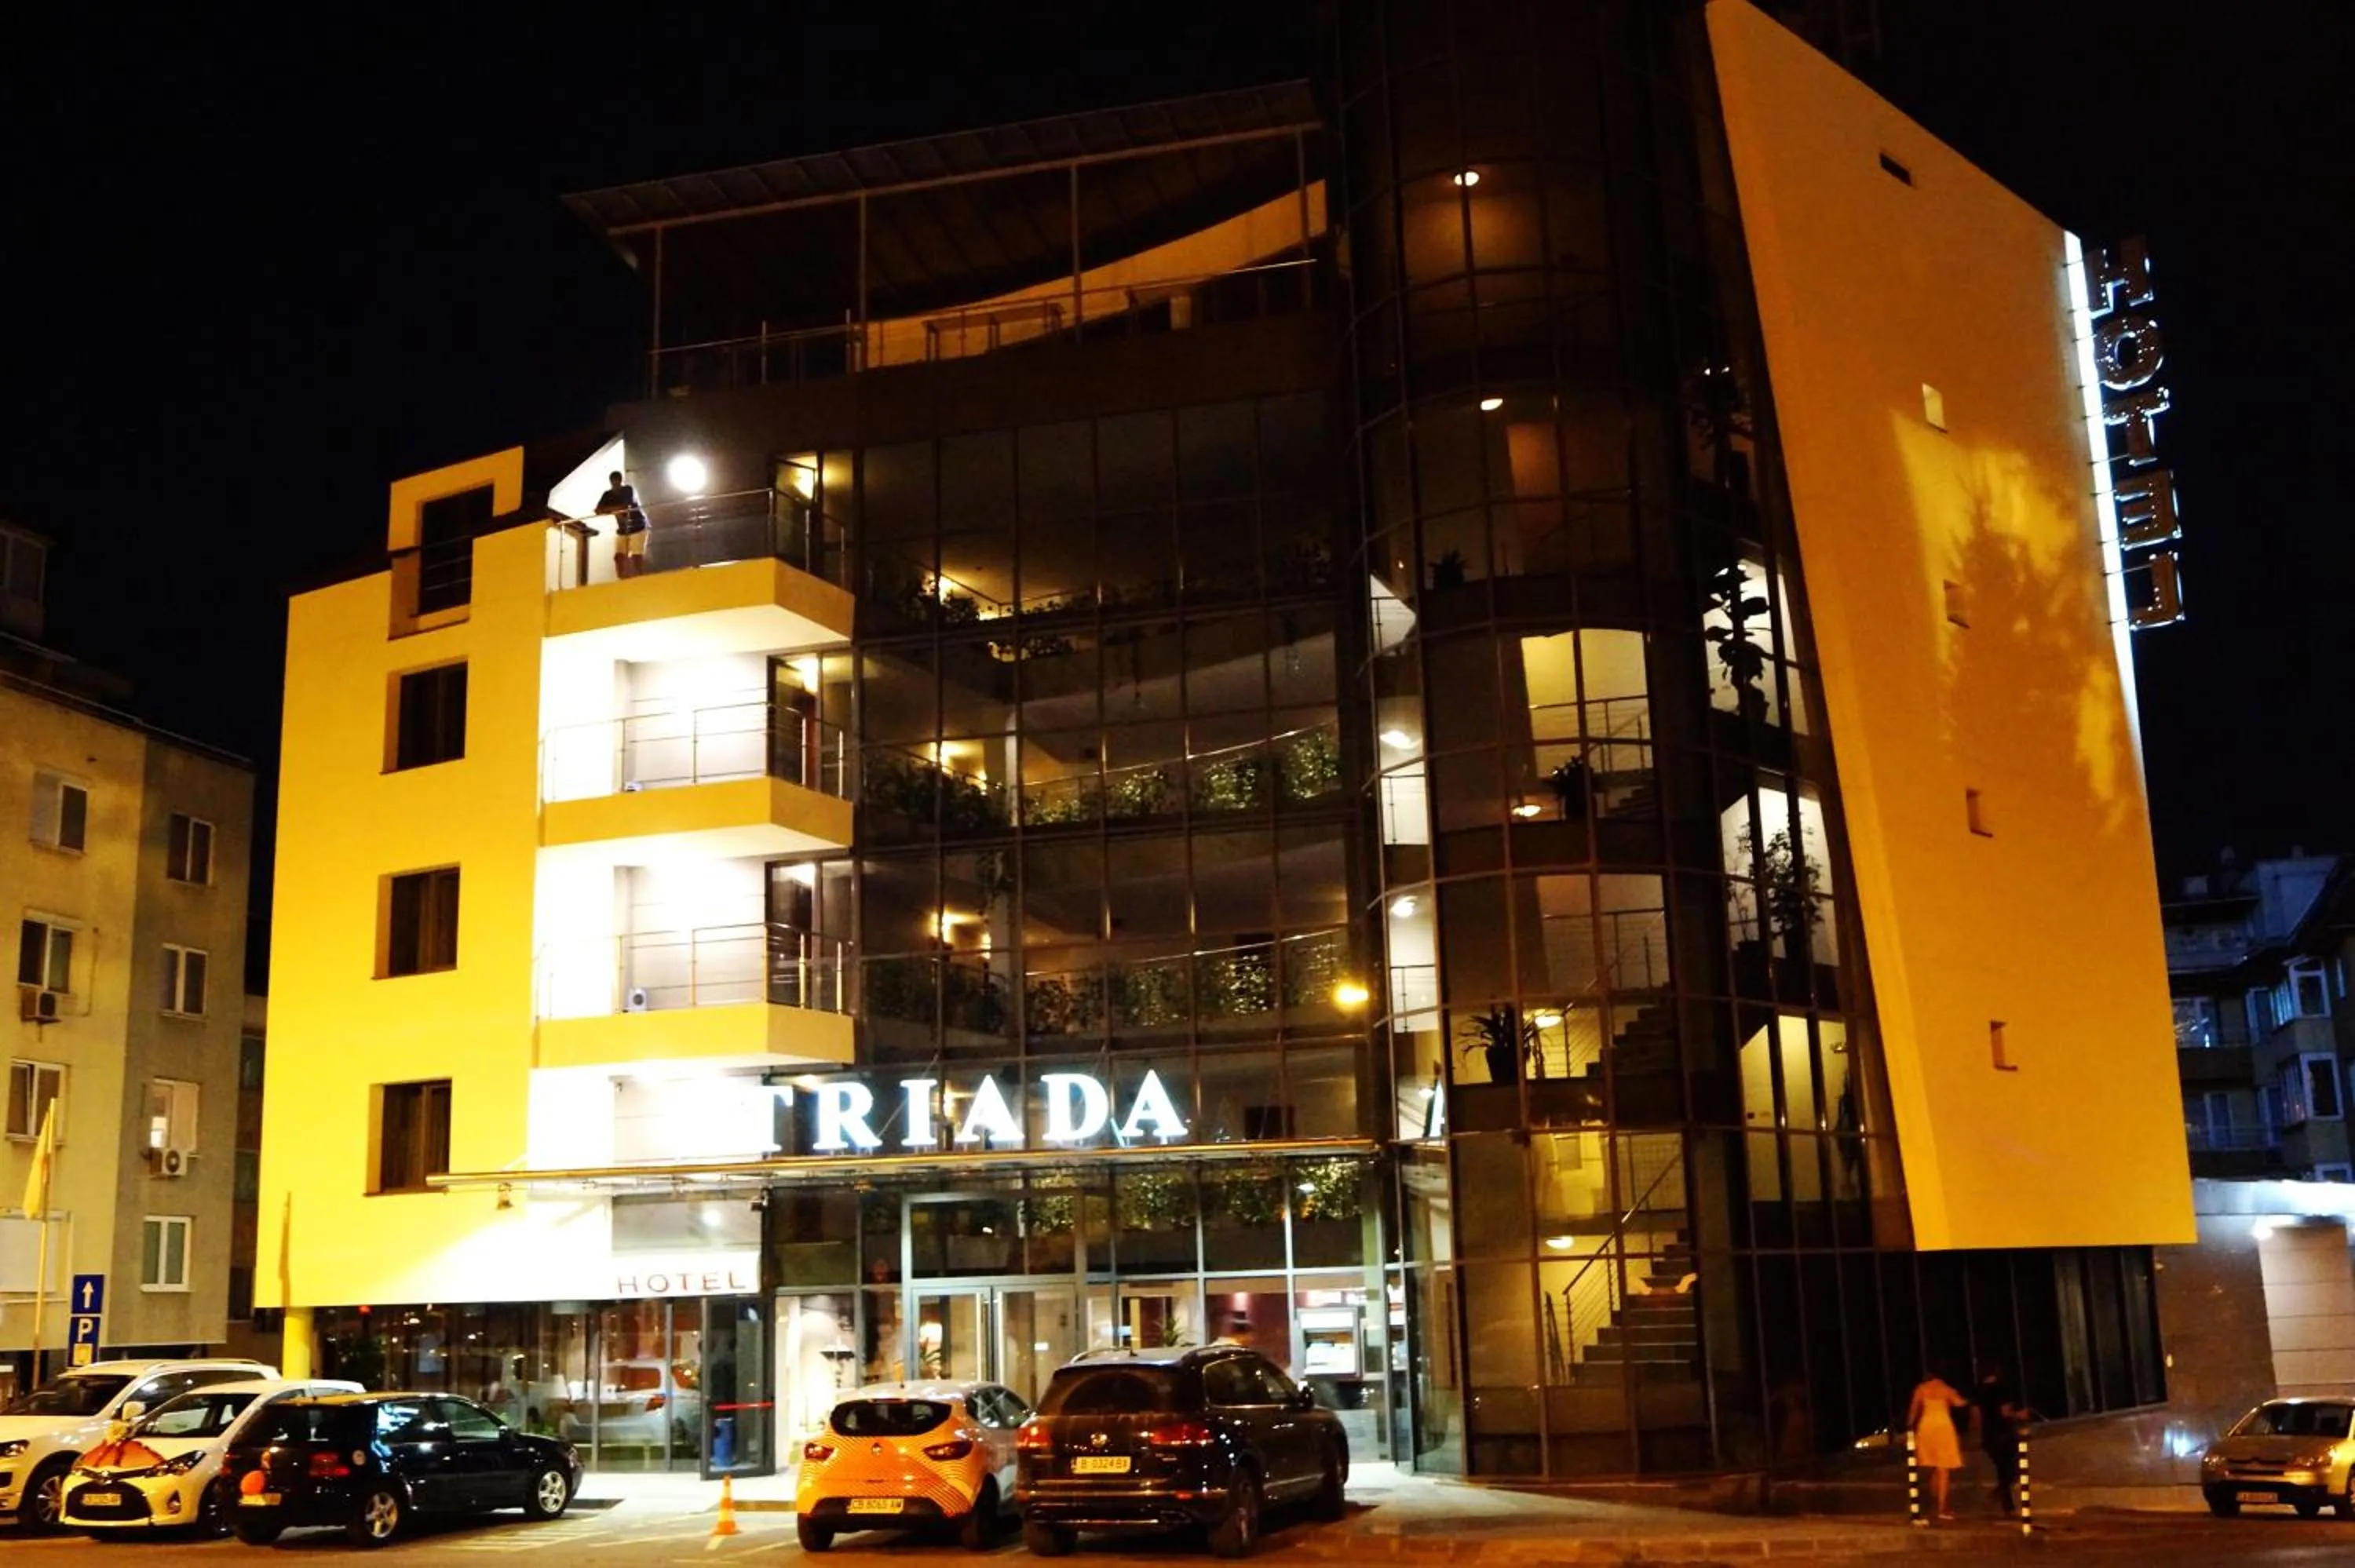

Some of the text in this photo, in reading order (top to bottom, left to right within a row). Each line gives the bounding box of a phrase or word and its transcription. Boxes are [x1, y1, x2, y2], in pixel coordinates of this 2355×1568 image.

[738, 1068, 1189, 1152] TRIADA
[617, 1271, 746, 1294] HOTEL
[77, 1318, 93, 1343] P
